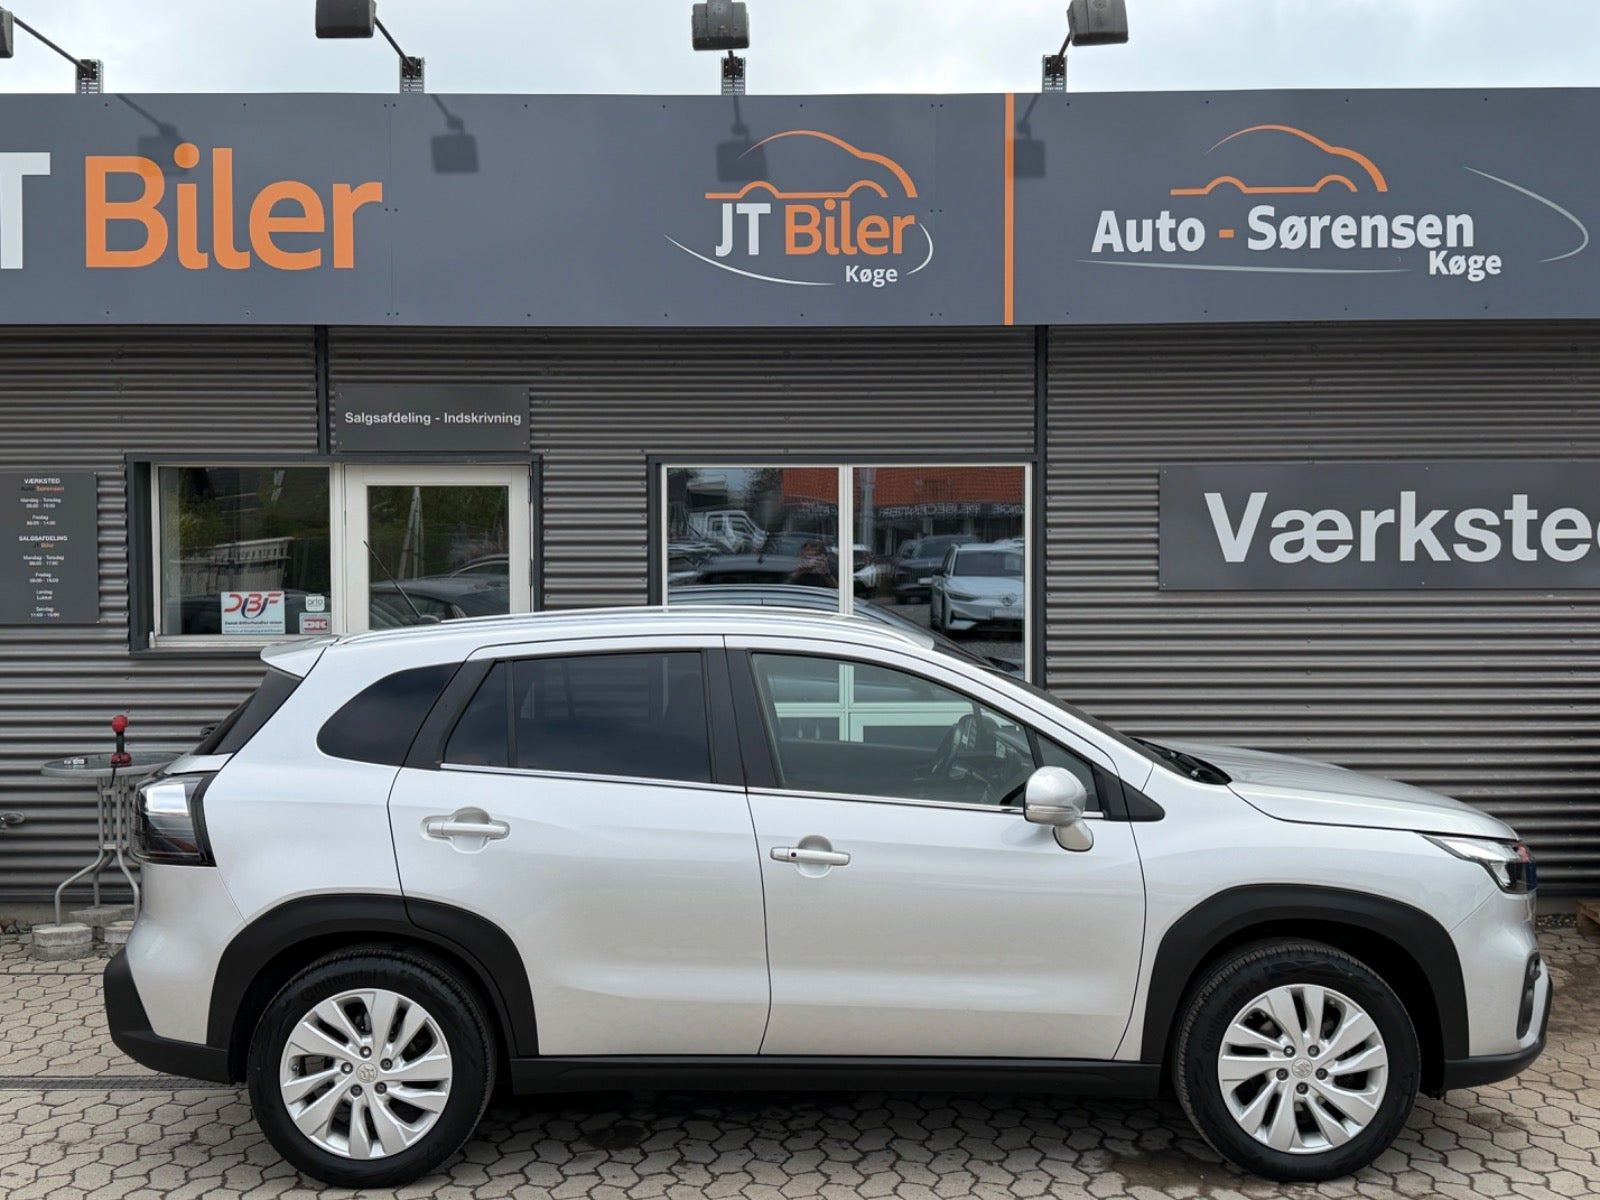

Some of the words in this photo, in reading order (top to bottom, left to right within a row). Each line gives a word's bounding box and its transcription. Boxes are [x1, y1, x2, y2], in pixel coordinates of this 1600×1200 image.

[85, 142, 383, 271] Biler
[715, 202, 772, 258] JT
[785, 198, 916, 256] Biler
[1091, 210, 1205, 253] Auto
[1218, 229, 1234, 238] -
[1247, 205, 1474, 251] Sørensen
[845, 265, 898, 288] Køge
[1429, 250, 1502, 282] Køge
[344, 411, 431, 427] Salgsafdeling
[444, 411, 522, 427] Indskrivning
[1204, 491, 1600, 564] Værkste
